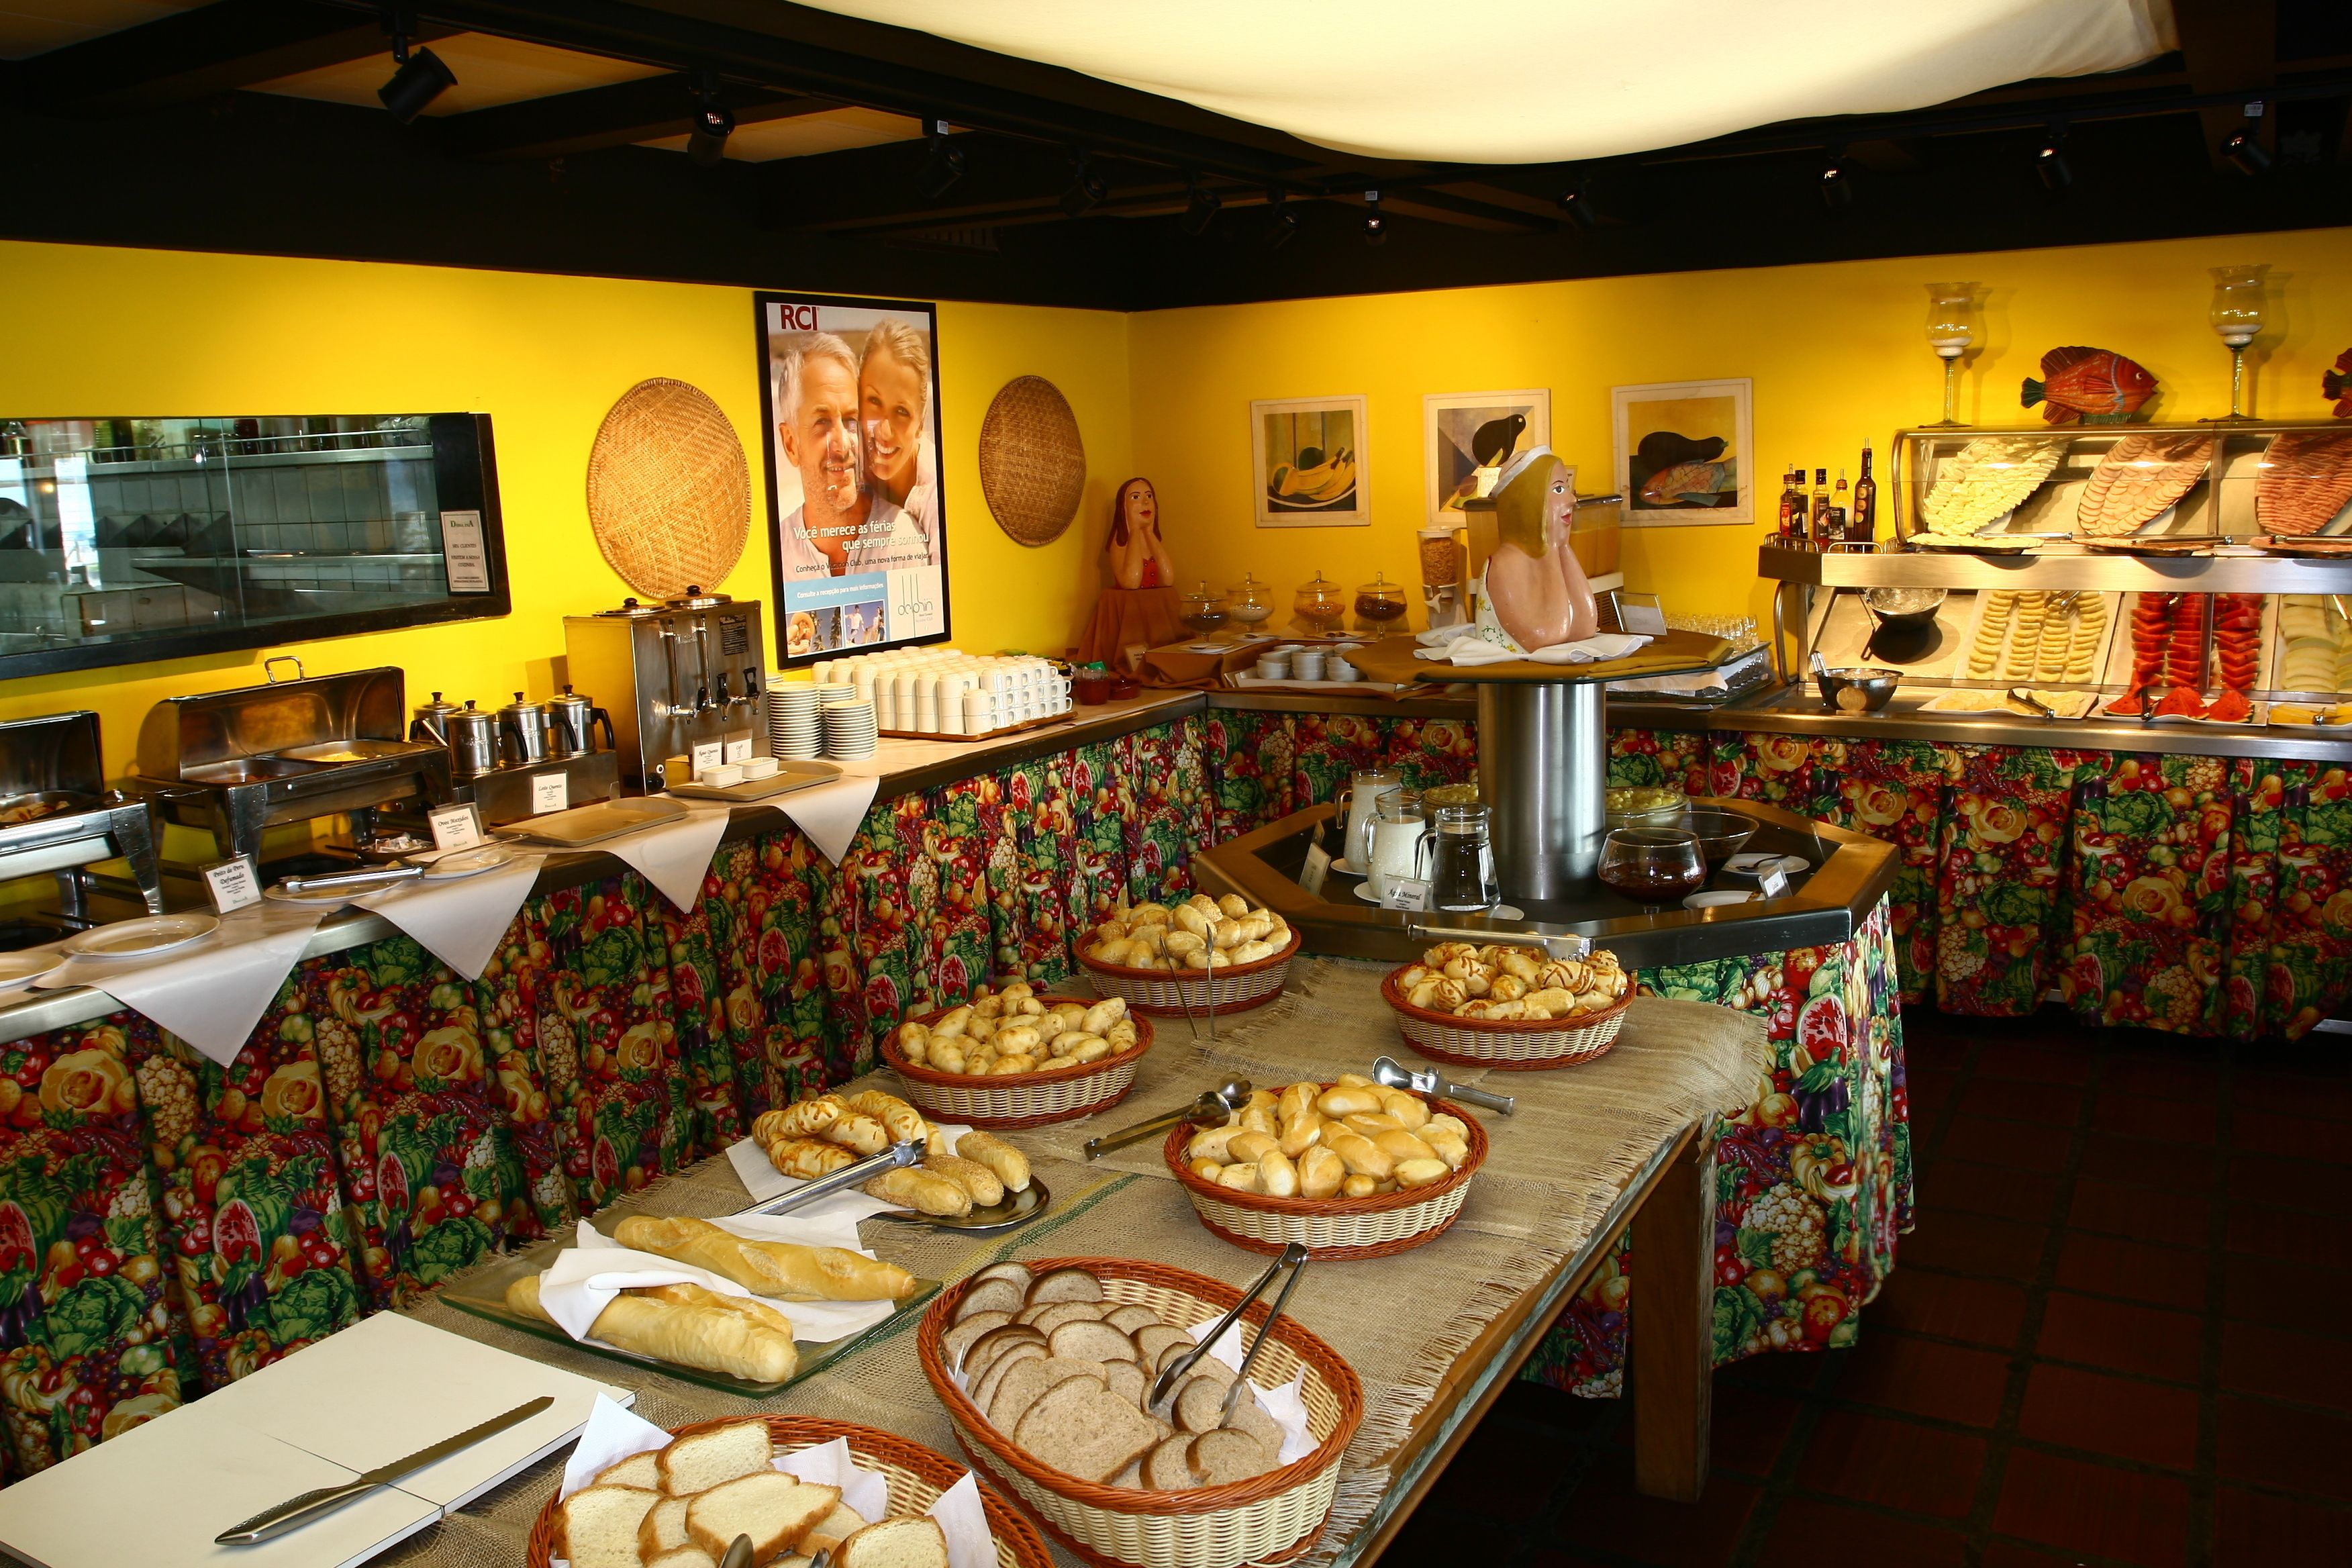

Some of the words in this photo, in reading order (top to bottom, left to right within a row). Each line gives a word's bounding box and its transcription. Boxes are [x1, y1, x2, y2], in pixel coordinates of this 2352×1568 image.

[780, 305, 818, 331] RCI
[793, 526, 818, 540] Você
[820, 525, 856, 538] merece
[858, 524, 868, 534] as
[869, 520, 896, 533] férias
[842, 538, 861, 553] que
[863, 536, 895, 550] sempre
[898, 532, 929, 546] sonhou
[795, 564, 820, 573] Conheça
[891, 554, 905, 562] forma
[797, 591, 816, 599] Consulte
